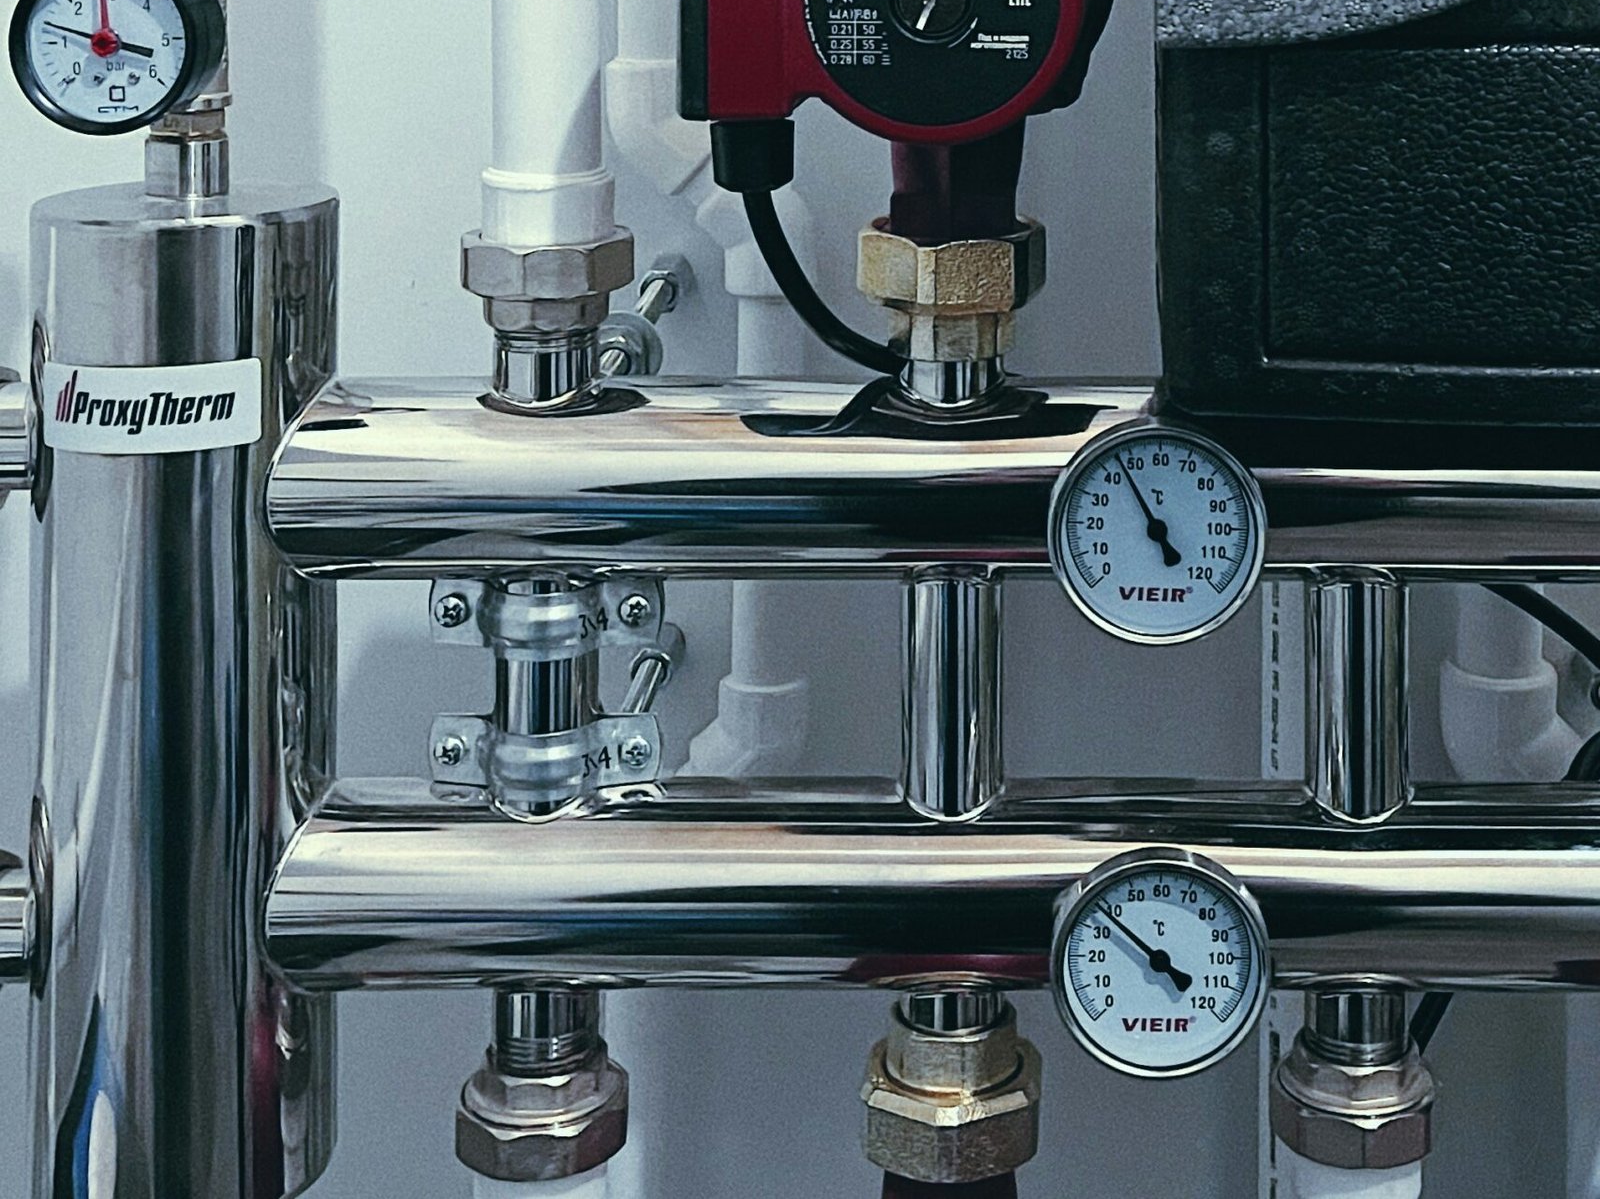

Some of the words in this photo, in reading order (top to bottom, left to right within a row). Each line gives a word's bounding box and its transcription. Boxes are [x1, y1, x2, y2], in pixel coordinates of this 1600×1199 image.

[74, 2, 83, 15] 2
[831, 24, 852, 35] 0.21
[862, 24, 875, 35] 50
[62, 36, 67, 48] 1
[161, 32, 170, 47] 5
[830, 39, 852, 50] 0.25
[862, 39, 875, 50] 55
[830, 54, 852, 64] 0.28
[862, 54, 875, 64] 60
[73, 62, 81, 76] 0
[106, 60, 125, 72] bar
[149, 65, 157, 79] 6
[72, 391, 236, 435] ProxyTherm
[1127, 457, 1144, 471] 50
[1152, 453, 1170, 467] 60
[1179, 459, 1196, 473] 70
[1104, 472, 1121, 485] 40
[1197, 477, 1214, 491] 80
[1091, 493, 1109, 506] 30
[1209, 499, 1227, 513] 90
[1086, 516, 1104, 530] 20
[1207, 522, 1231, 536] 100
[1092, 542, 1108, 555] 10
[1201, 545, 1226, 559] 110
[1102, 562, 1111, 575] 0
[1188, 566, 1213, 580] 120
[1128, 889, 1145, 902] 50
[1153, 884, 1170, 897] 60
[1180, 890, 1197, 903] 70
[1199, 907, 1216, 921] 80
[1093, 926, 1111, 939] 30
[1211, 929, 1228, 943] 90
[1088, 950, 1106, 963] 20
[1209, 952, 1234, 965] 100
[1094, 974, 1111, 988] 10
[1203, 975, 1228, 988] 110
[1105, 994, 1114, 1008] 0
[1190, 996, 1216, 1009] 120
